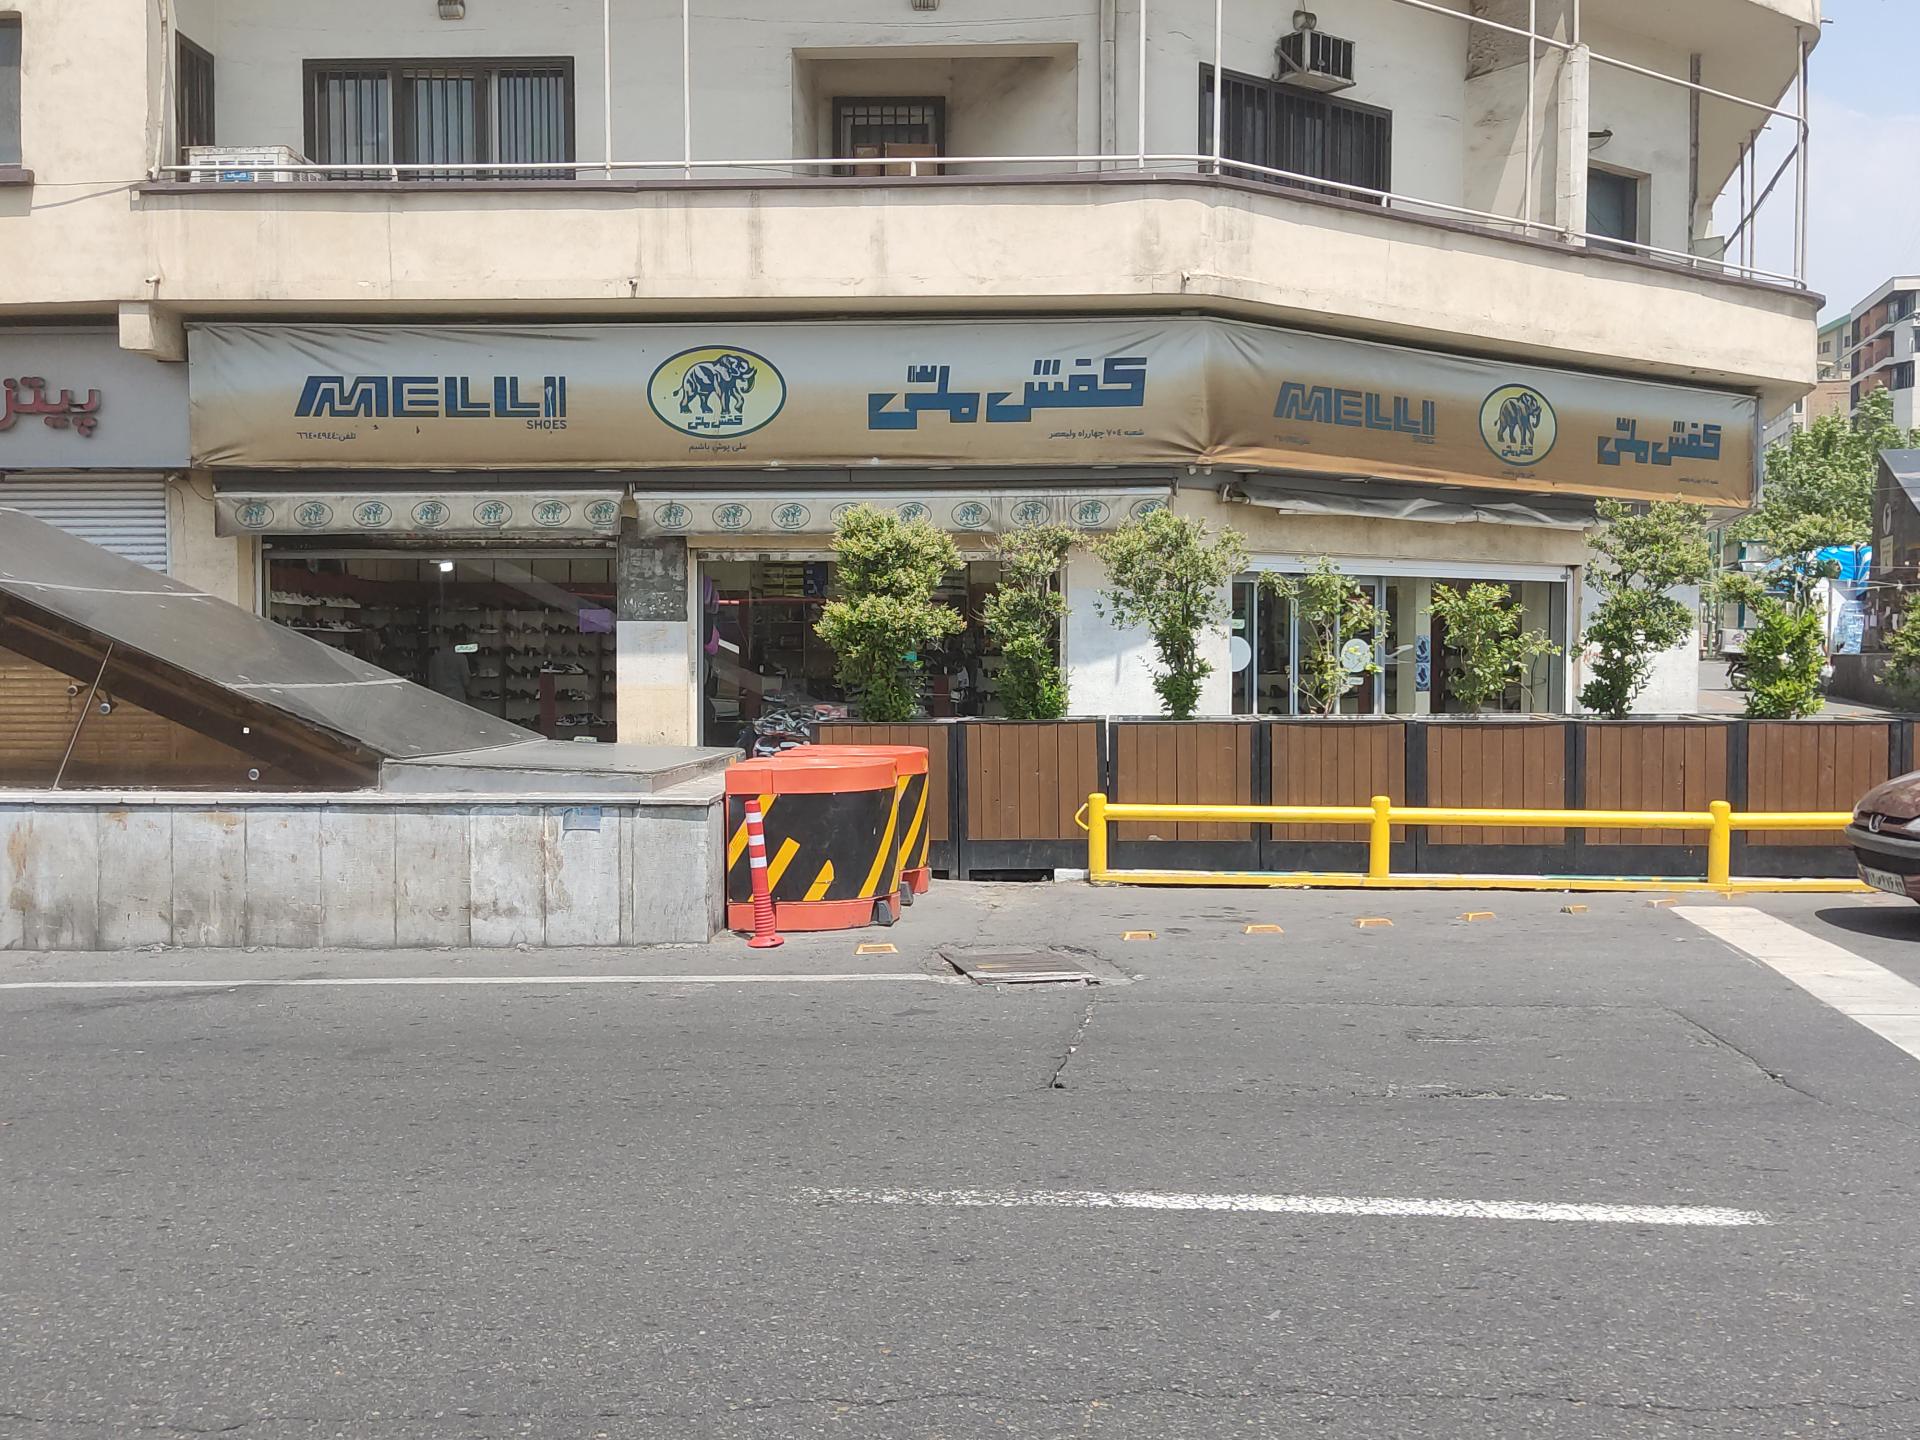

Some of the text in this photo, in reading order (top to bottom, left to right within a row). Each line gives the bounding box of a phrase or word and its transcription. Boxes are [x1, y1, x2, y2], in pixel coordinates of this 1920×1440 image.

[294, 376, 567, 417] MELLI
[986, 357, 1148, 422] کفش
[1273, 381, 1435, 435] MELLI
[526, 419, 567, 430] SHOES
[1651, 421, 1722, 466] کفش
